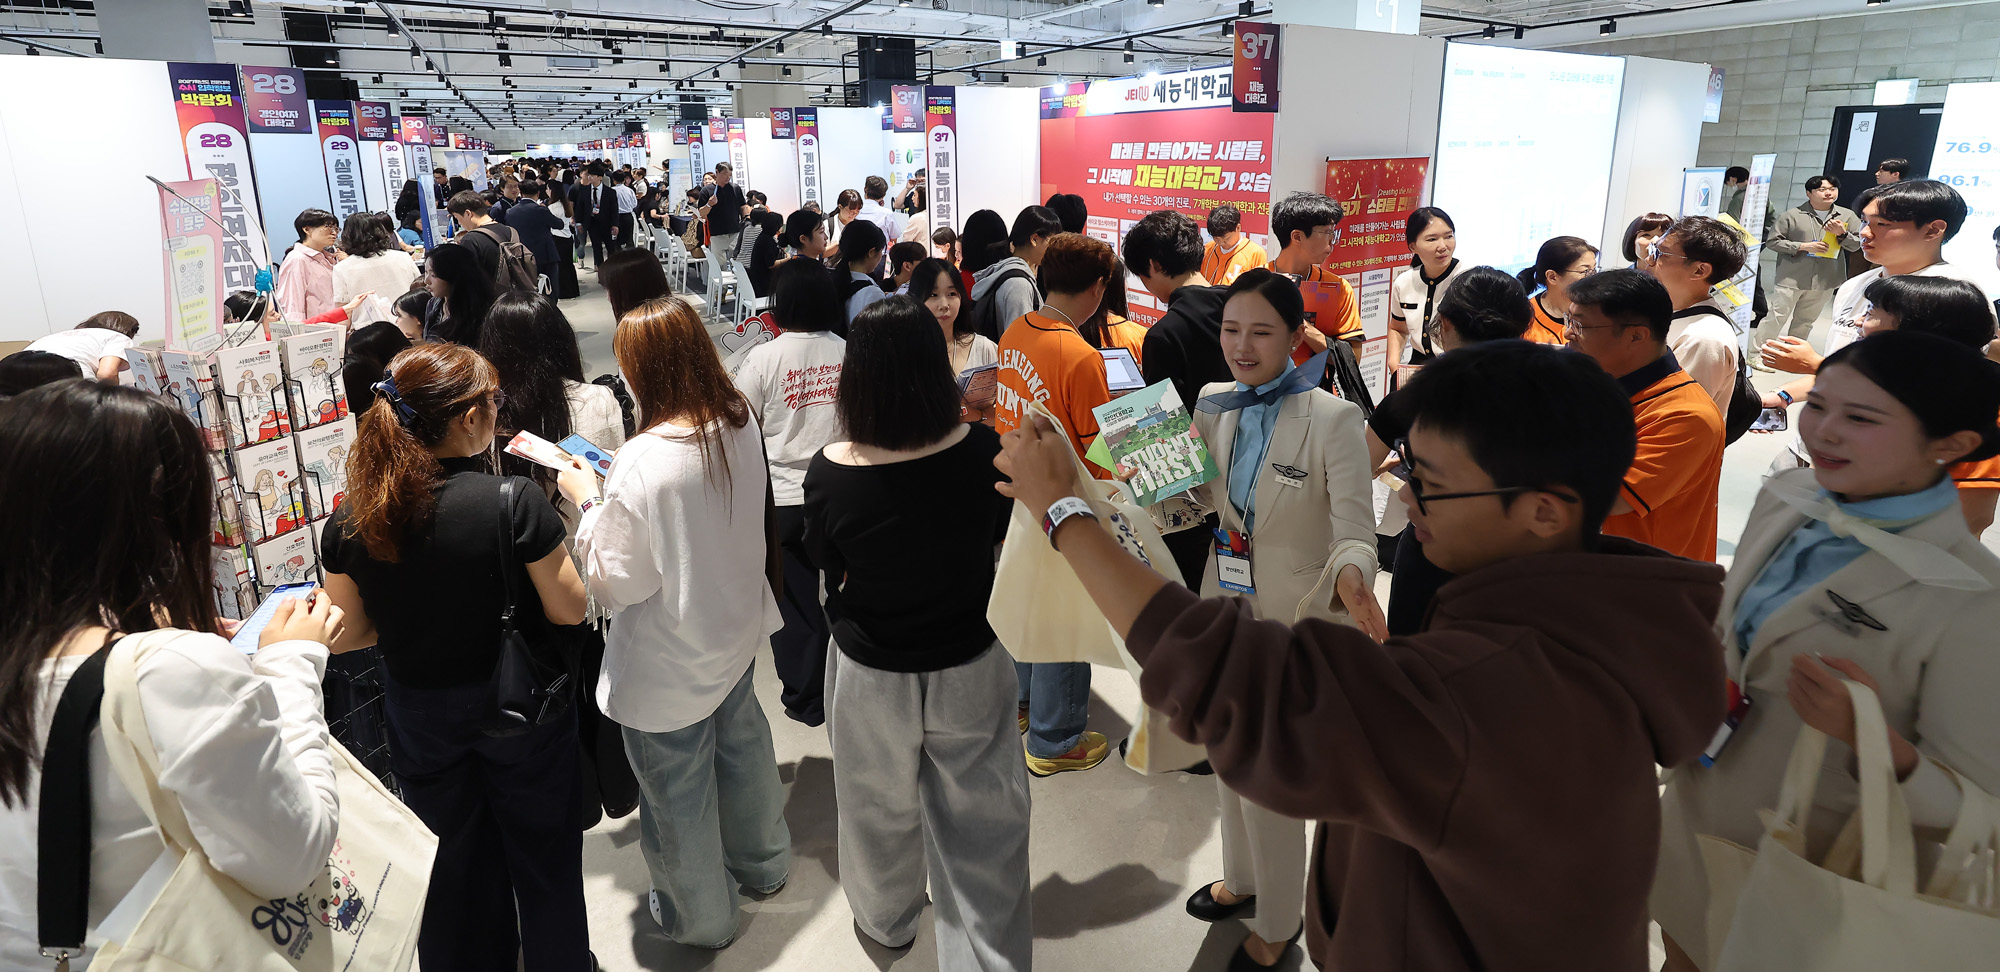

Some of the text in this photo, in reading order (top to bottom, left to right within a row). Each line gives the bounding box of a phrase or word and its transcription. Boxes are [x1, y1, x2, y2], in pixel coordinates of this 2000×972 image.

[1242, 32, 1275, 60] 37
[198, 84, 232, 92] 입학정보
[252, 73, 297, 95] 28
[1153, 73, 1232, 103] 재능대학교
[1248, 80, 1264, 92] 재능
[1709, 73, 1722, 90] 46
[180, 93, 233, 107] 박람회
[897, 90, 919, 105] 37
[1244, 92, 1268, 105] 대학교
[258, 109, 300, 118] 경인여자
[360, 106, 386, 118] 29
[773, 110, 790, 121] 38
[928, 105, 952, 115] 박람회
[264, 118, 296, 128] 대학교
[320, 118, 350, 126] 박람회
[405, 120, 424, 129] 30
[431, 127, 445, 135] 31
[934, 132, 949, 142] 37
[200, 134, 232, 148] 28
[330, 142, 349, 150] 29
[802, 138, 814, 146] 38
[1110, 140, 1266, 164] 미래를 만들어가는 사람들,
[1086, 168, 1098, 184] 그
[1099, 168, 1133, 186] 시작에
[1134, 164, 1236, 191] 재능대학교가
[1103, 192, 1115, 203] 내가
[1115, 192, 1133, 204] 선택할
[1133, 194, 1139, 204] 수
[1140, 194, 1152, 206] 있는
[1153, 196, 1176, 208] 30개의
[1176, 196, 1192, 210] 진로,
[1193, 198, 1220, 211] 7개학부
[1367, 198, 1396, 214] 스타를
[205, 162, 255, 297] 경인여자대
[1349, 224, 1364, 234] 미래를
[1366, 222, 1390, 232] 만들어가는
[1340, 238, 1347, 248] 그
[1348, 236, 1364, 248] 시작에
[1365, 233, 1396, 246] 재능대학교가
[238, 354, 271, 365] 사회복지학과
[258, 449, 288, 462] 유아교육학과
[1121, 431, 1196, 474] STUDENT
[1129, 449, 1205, 498] FIRST
[286, 540, 306, 552] 간호학과
